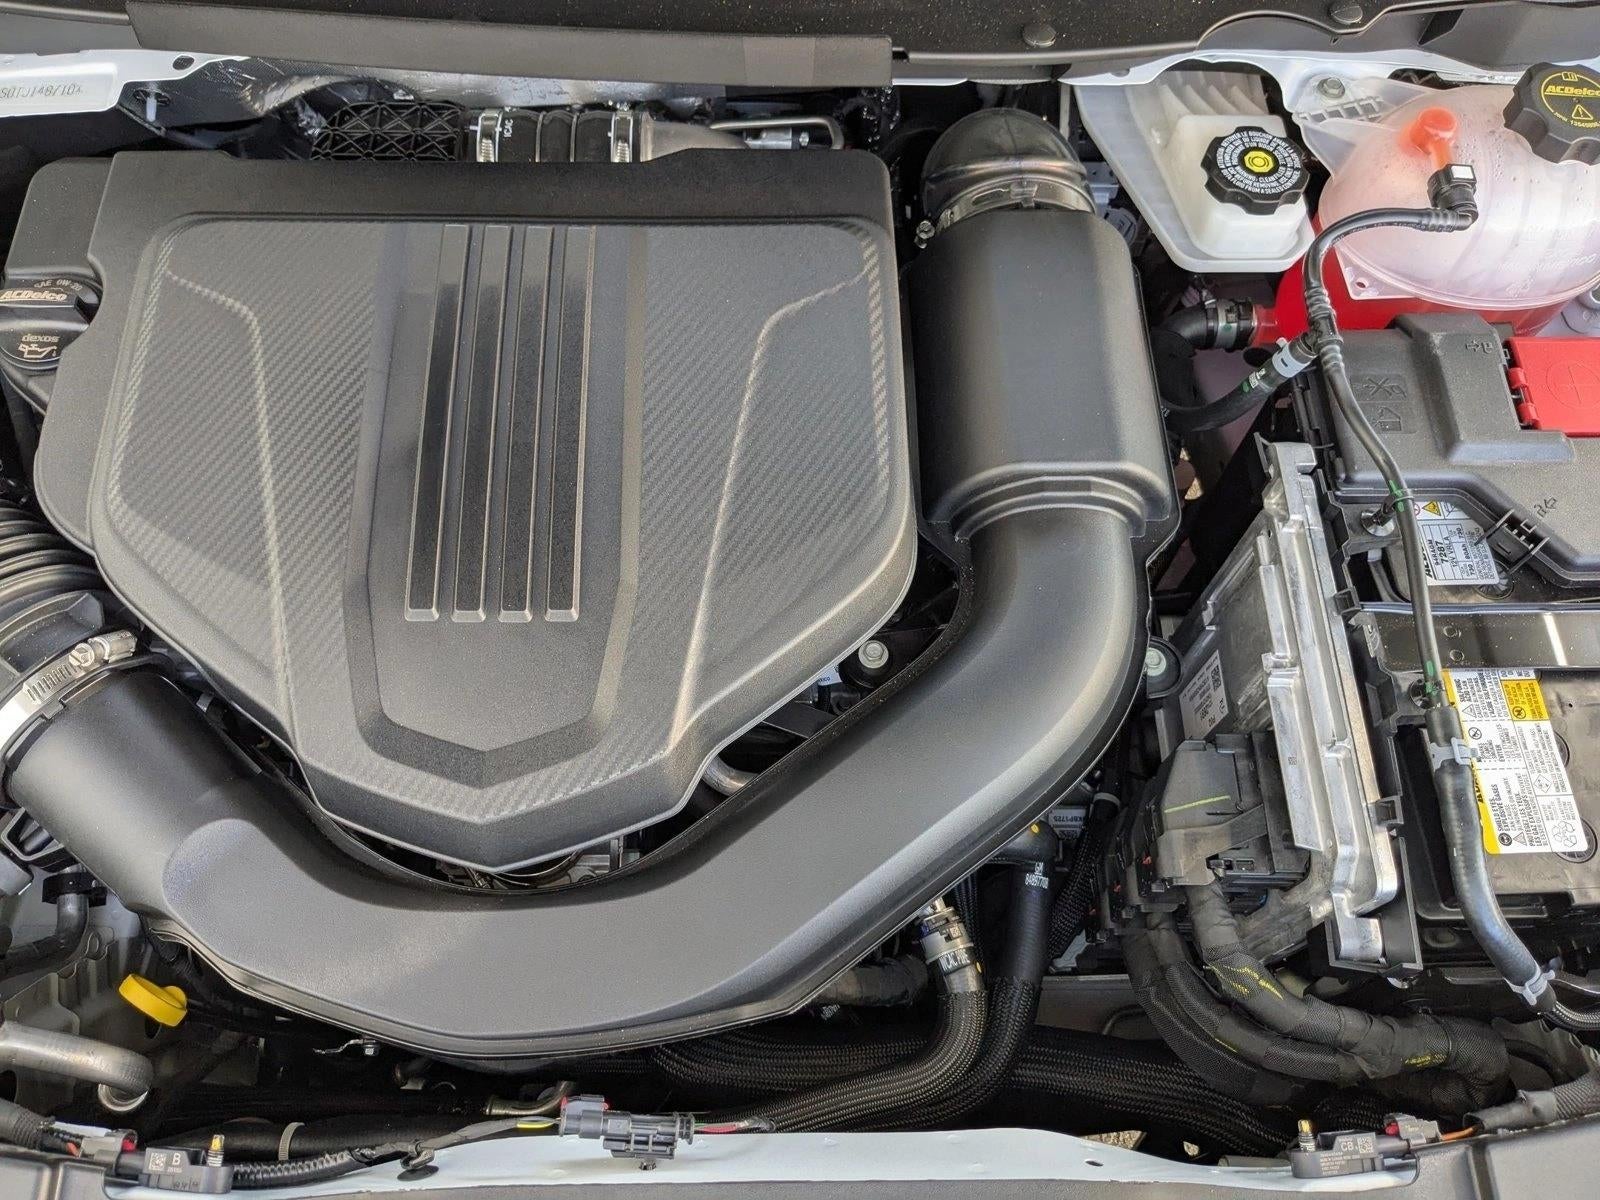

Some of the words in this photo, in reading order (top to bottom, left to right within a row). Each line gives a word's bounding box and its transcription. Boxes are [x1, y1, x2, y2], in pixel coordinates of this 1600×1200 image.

[0, 290, 68, 301] ACDelco
[21, 333, 60, 343] dexos
[1434, 540, 1448, 563] 7287
[1467, 563, 1475, 575] 730
[1453, 678, 1465, 702] SULFURIC
[1467, 677, 1478, 702] BLINDNESS
[1490, 783, 1501, 800] GASES
[1496, 802, 1510, 831] EXPLOSIVE
[1503, 804, 1513, 819] CAUSE
[1510, 803, 1523, 830] BLINDNESS
[1518, 808, 1526, 817] LES
[1521, 794, 1535, 823] EXPLOSIFS
[1493, 812, 1503, 831] SHIELD
[1530, 824, 1538, 835] GAZ
[1533, 836, 1542, 846] LES
[172, 1152, 181, 1166] B
